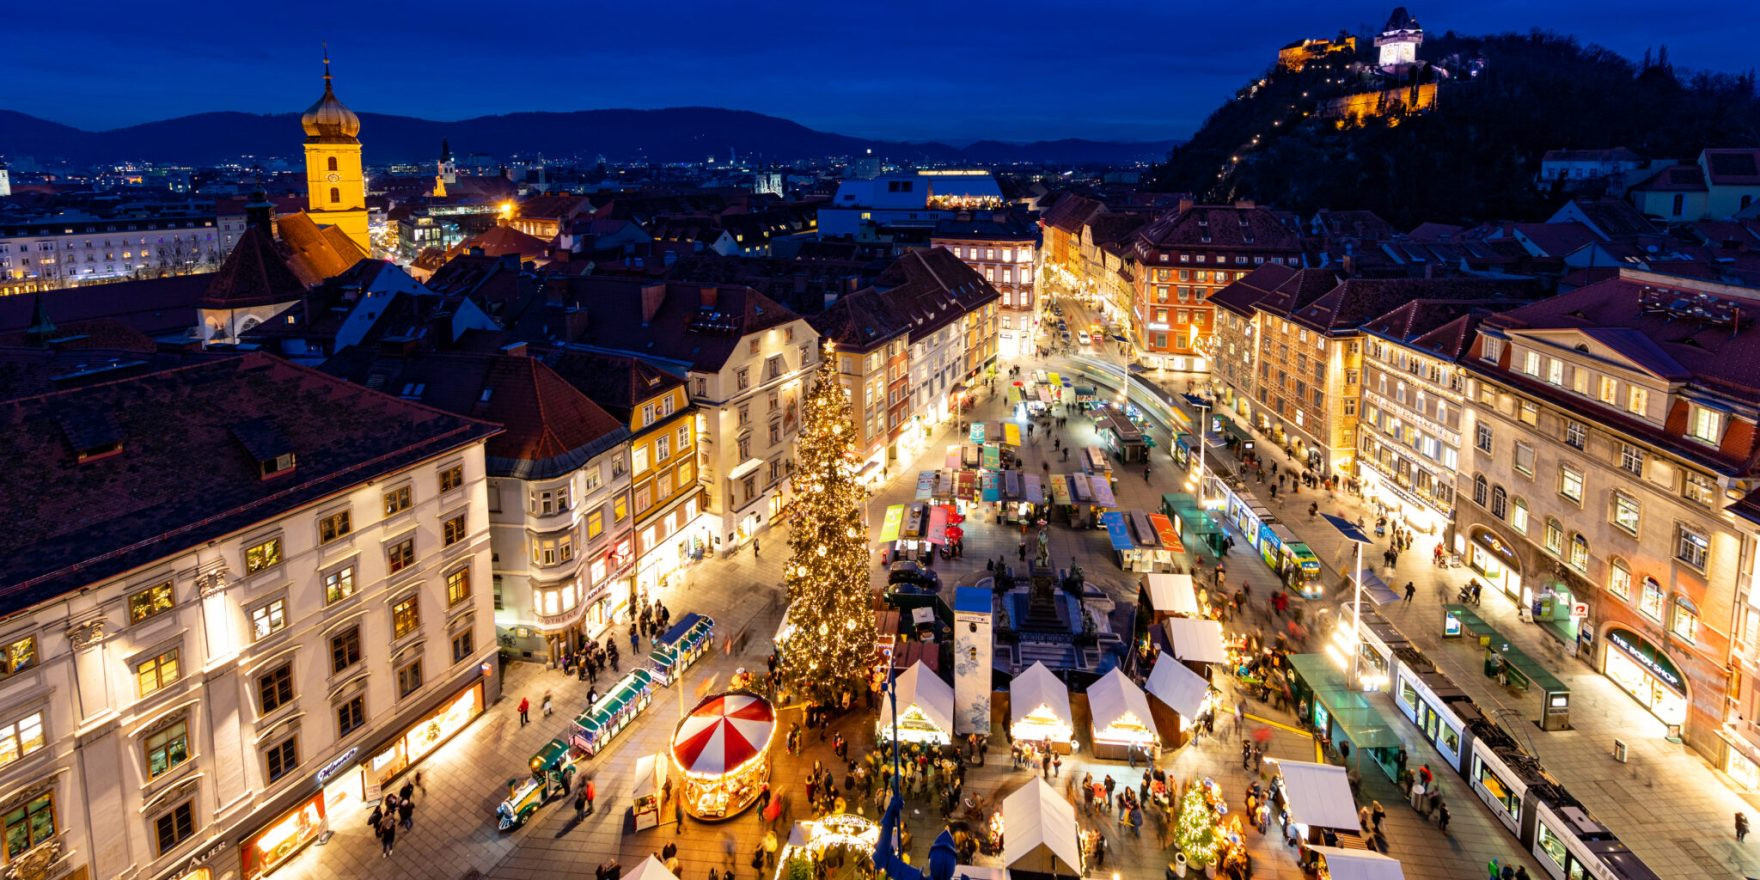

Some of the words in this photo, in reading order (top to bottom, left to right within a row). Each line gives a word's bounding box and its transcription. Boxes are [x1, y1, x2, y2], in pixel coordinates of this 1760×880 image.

[1612, 633, 1629, 650] THE
[1629, 646, 1654, 667] BODY
[1653, 663, 1678, 684] SHOP
[186, 840, 227, 873] AUER
